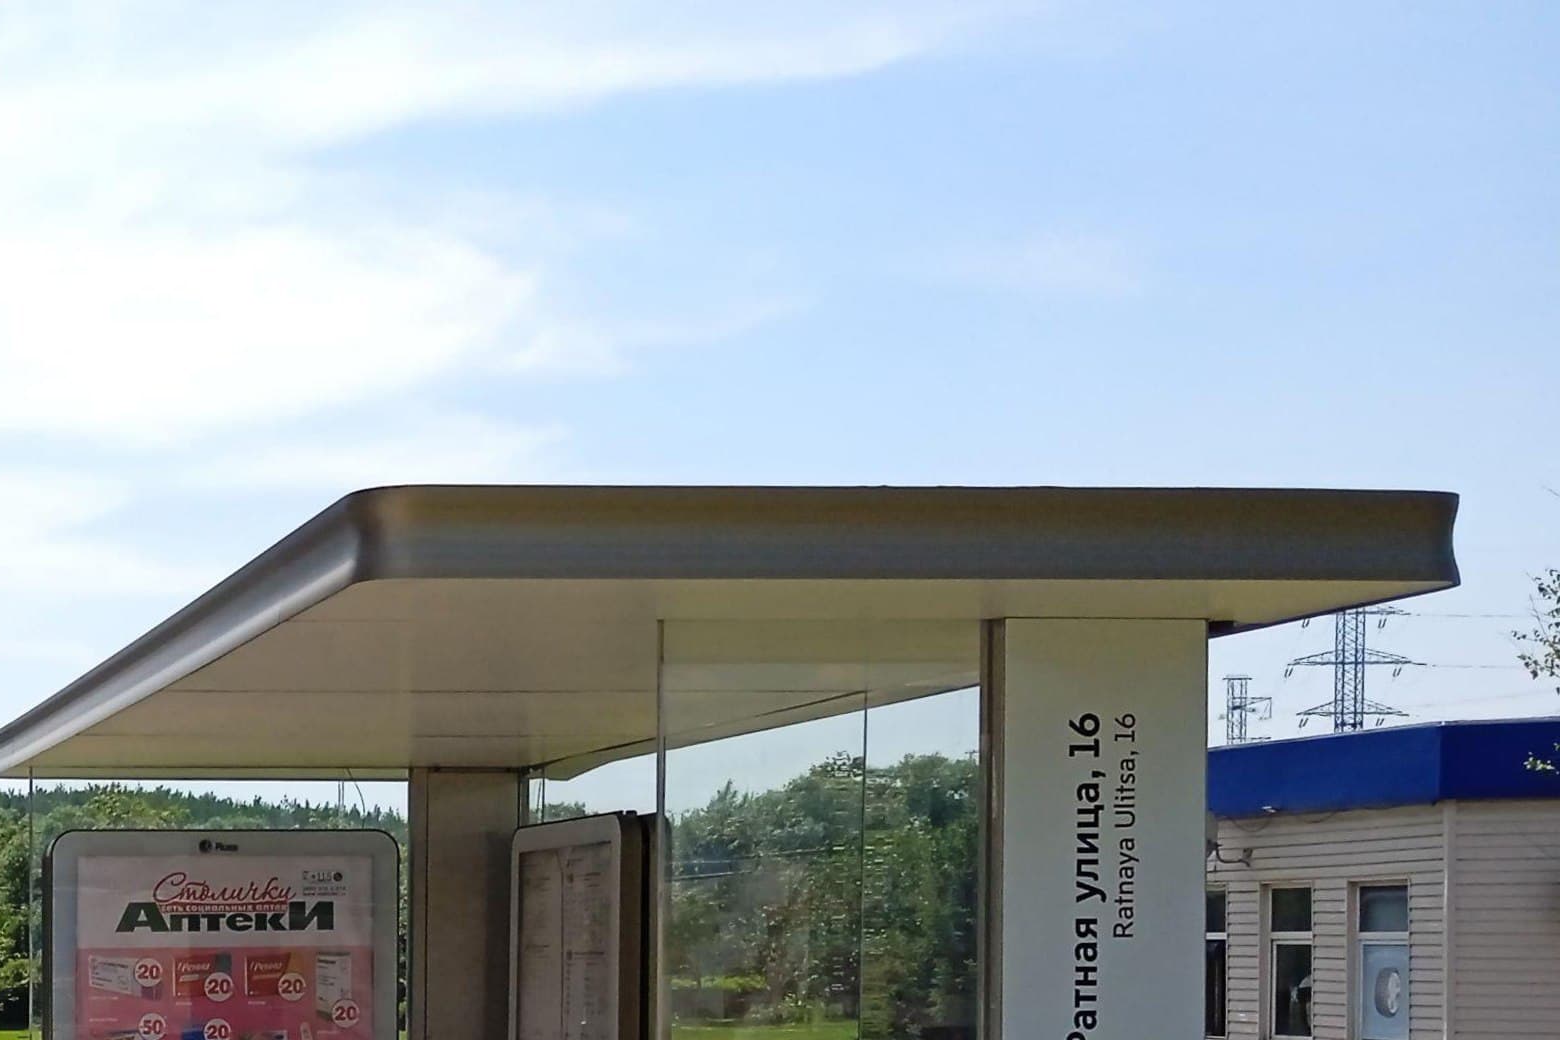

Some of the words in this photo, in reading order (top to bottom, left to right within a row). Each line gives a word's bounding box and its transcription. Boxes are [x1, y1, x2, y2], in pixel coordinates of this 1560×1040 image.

[1068, 712, 1100, 757] 16
[1114, 713, 1136, 742] 16
[1114, 750, 1140, 827] Ulitsa,
[1076, 770, 1107, 903] улица,
[153, 871, 296, 902] Столички
[1113, 838, 1140, 938] Ratnaya
